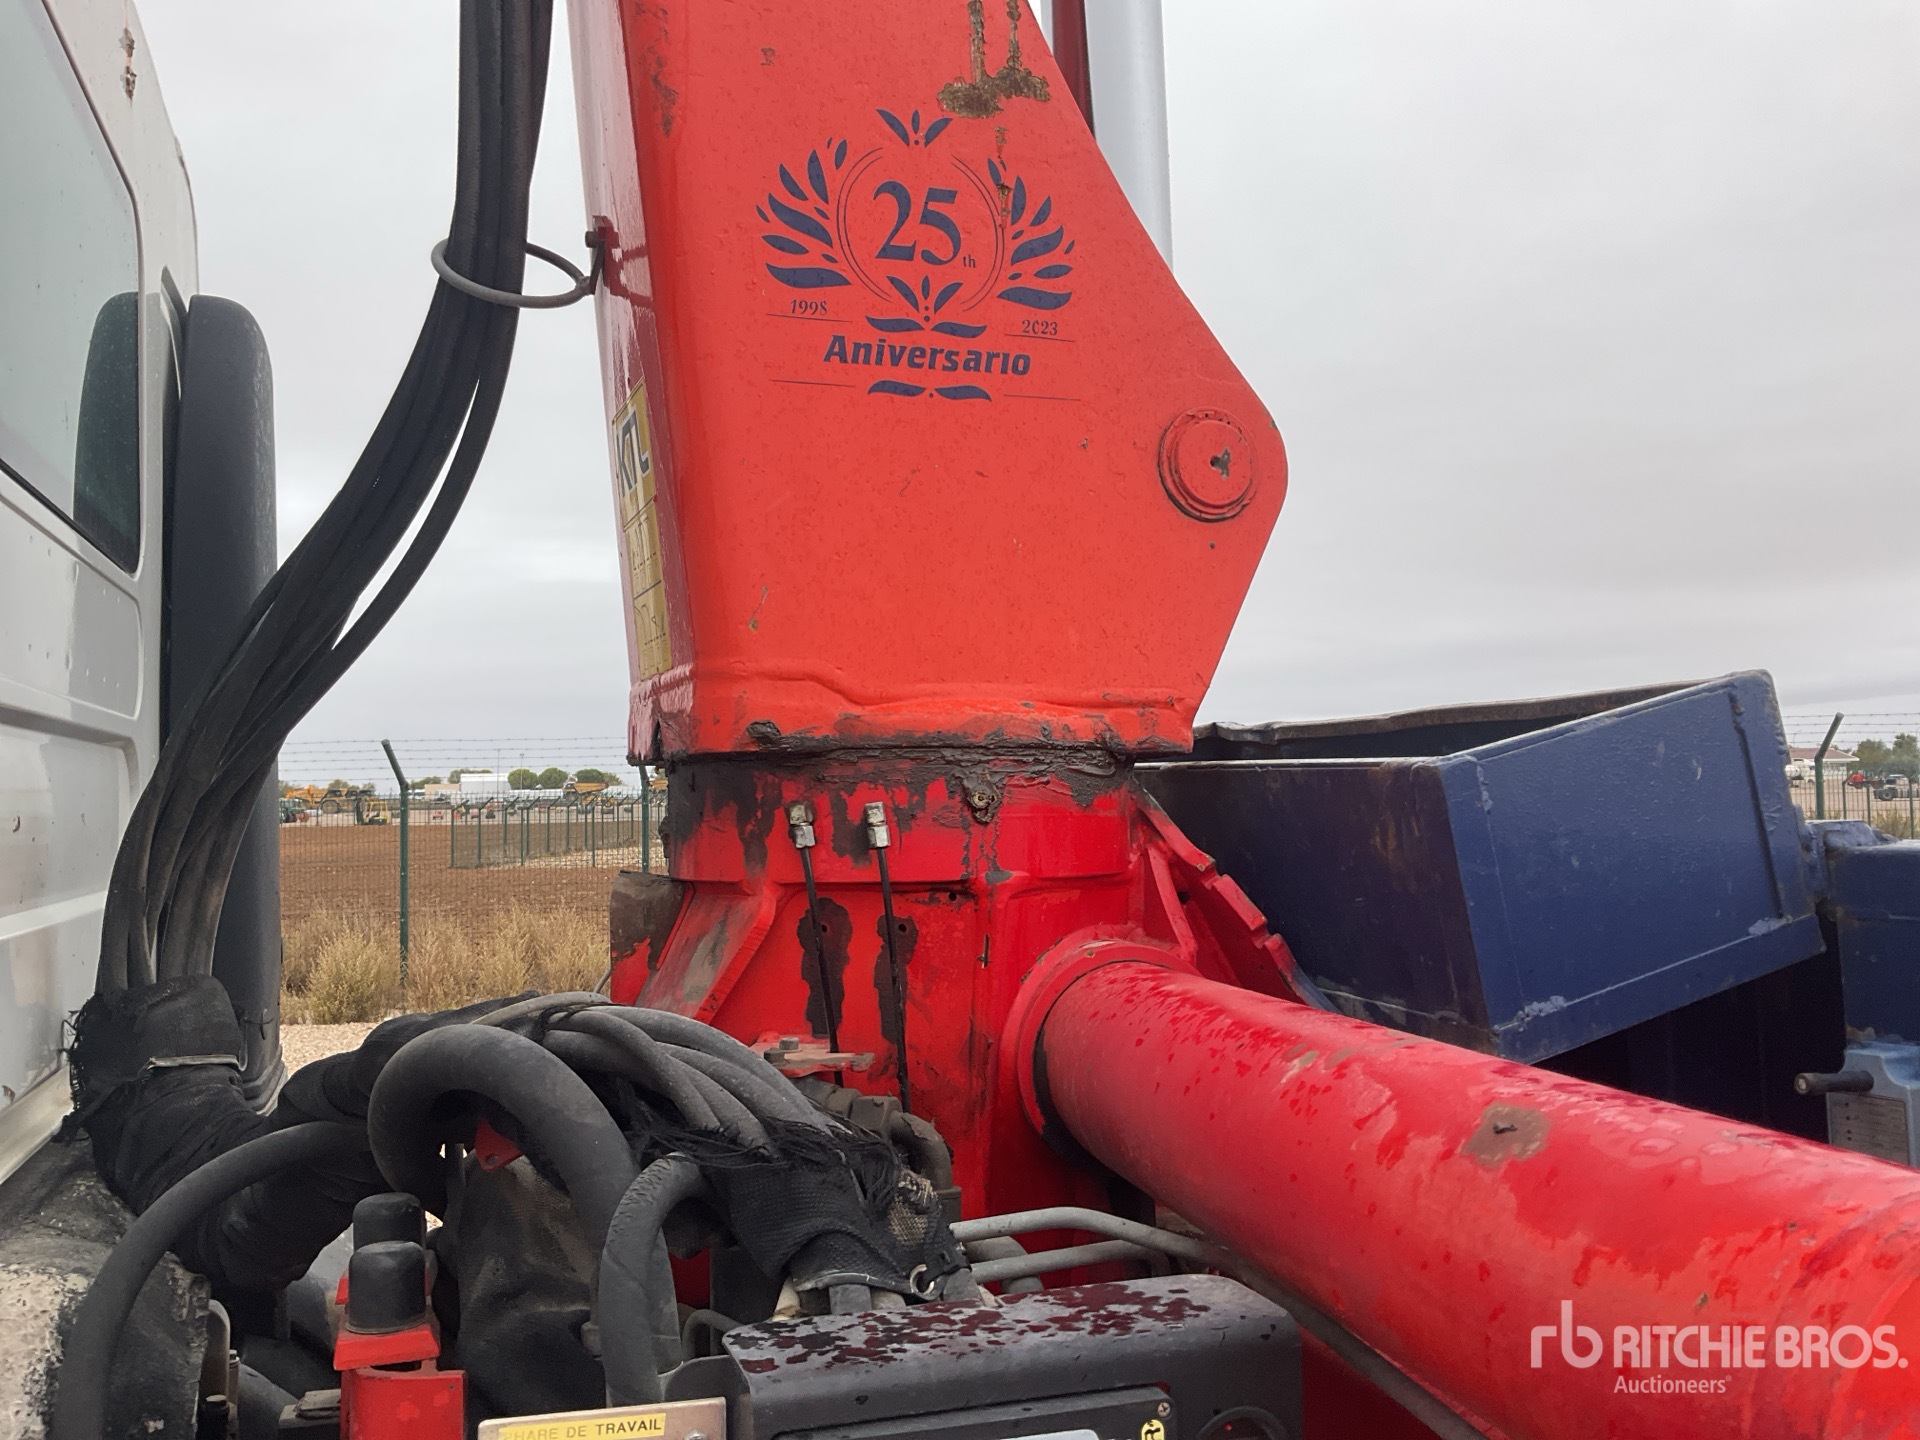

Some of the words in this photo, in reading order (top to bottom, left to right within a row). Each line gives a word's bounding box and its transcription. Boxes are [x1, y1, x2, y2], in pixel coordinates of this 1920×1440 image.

[873, 180, 962, 265] 25
[791, 299, 828, 316] 1998
[1022, 319, 1058, 336] 2023
[823, 334, 1031, 376] Aniversario
[566, 1426, 587, 1438] DE
[596, 1419, 662, 1436] TRAVAIL
